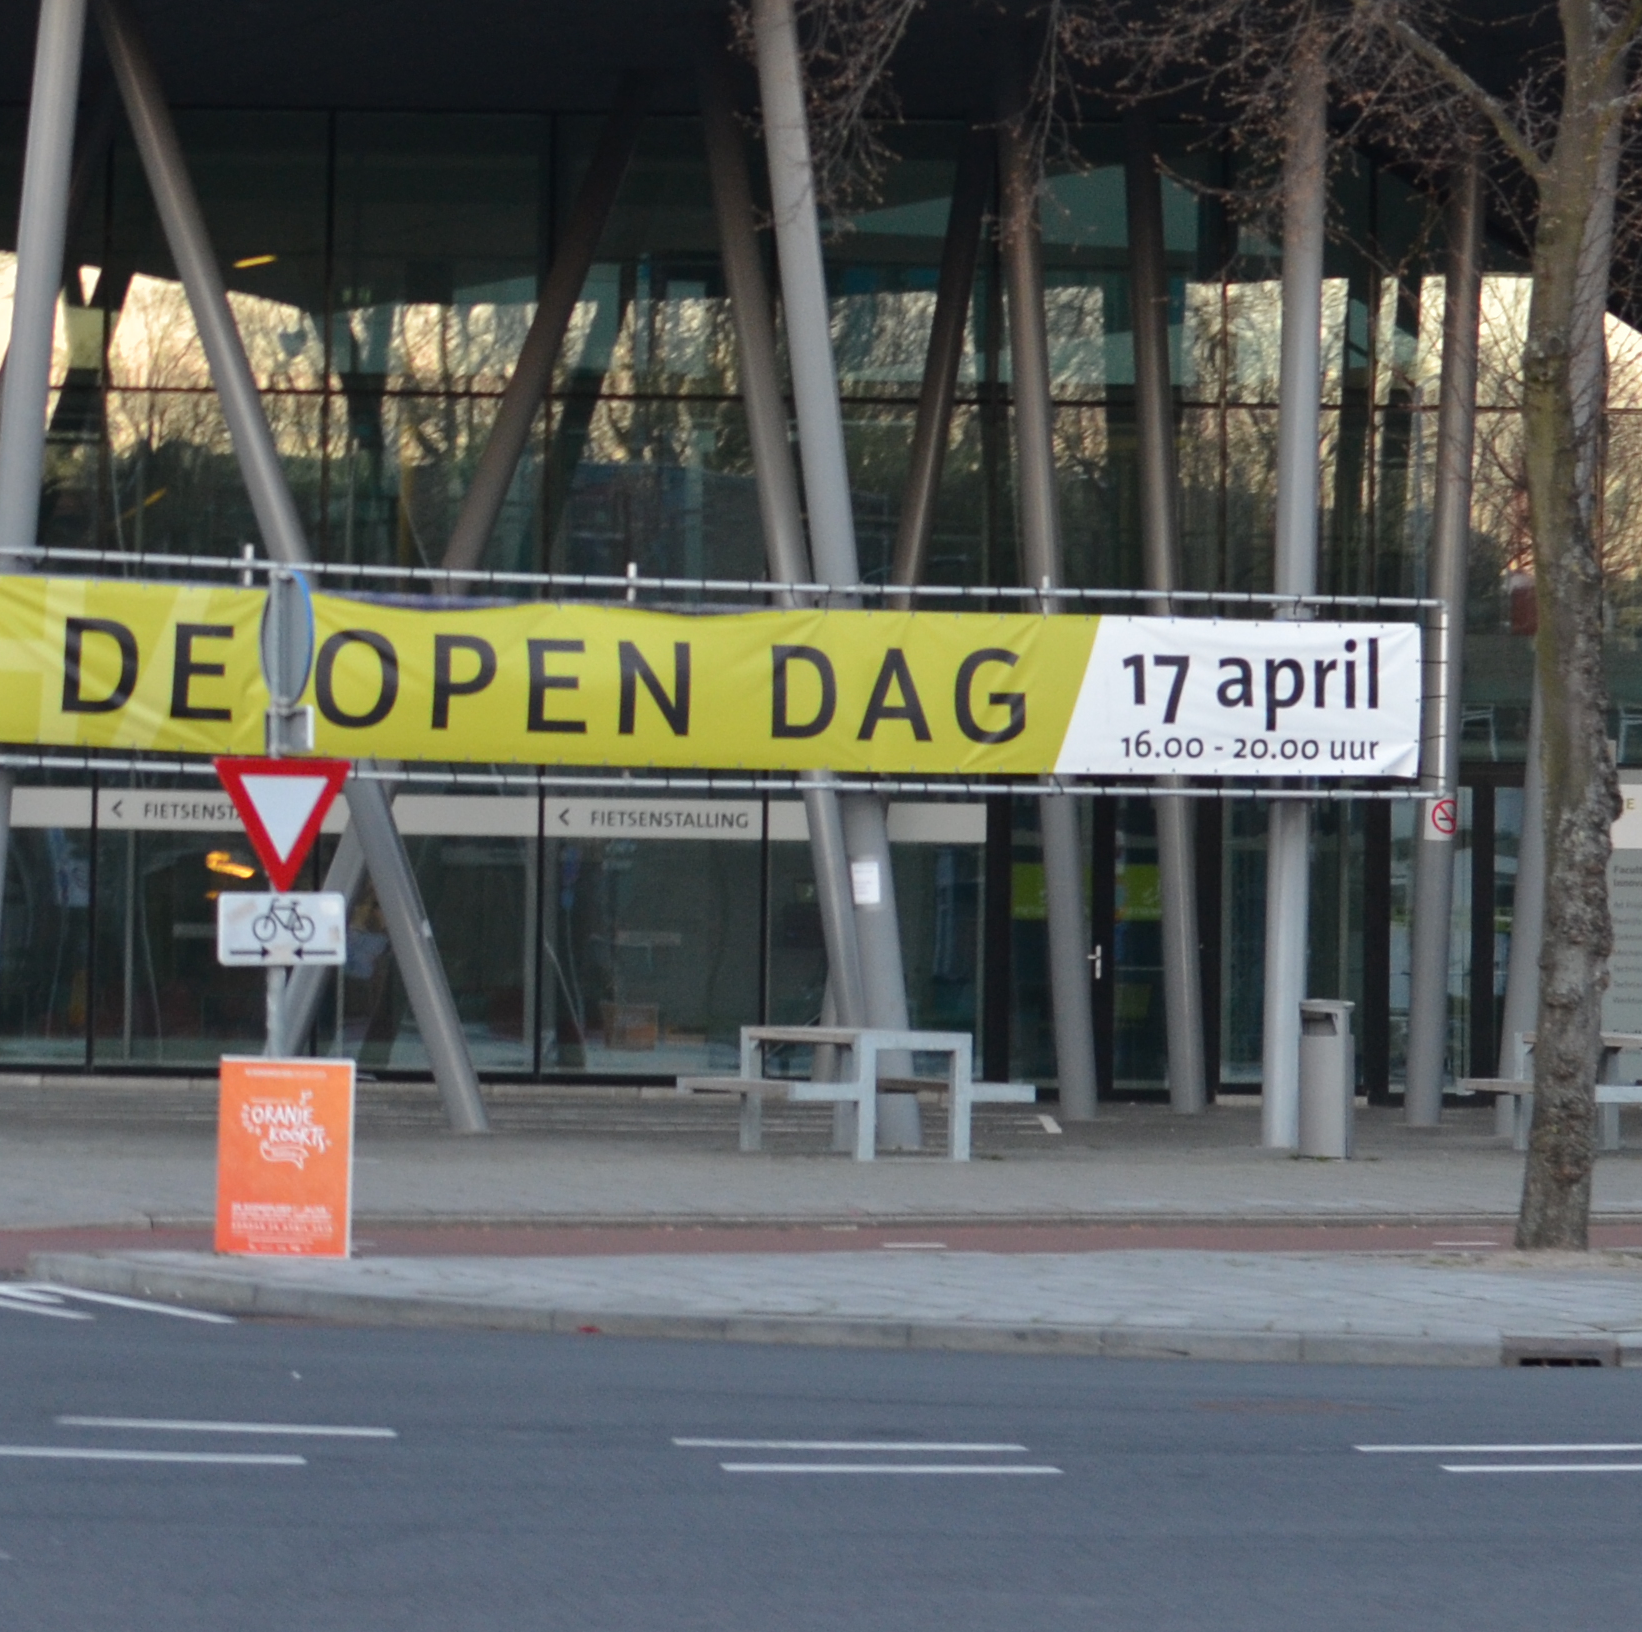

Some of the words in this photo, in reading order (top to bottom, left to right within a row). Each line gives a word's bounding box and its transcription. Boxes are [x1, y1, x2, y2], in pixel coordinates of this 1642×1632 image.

[61, 616, 235, 722] DE
[315, 628, 691, 737] OPEN
[771, 644, 1026, 744] DAG
[1123, 654, 1190, 724] 17
[1217, 637, 1379, 732] april
[1121, 730, 1204, 759] 16.00
[1233, 738, 1319, 760] 20.00
[1330, 740, 1380, 760] uur
[590, 809, 749, 829] FIETSENSTALLING
